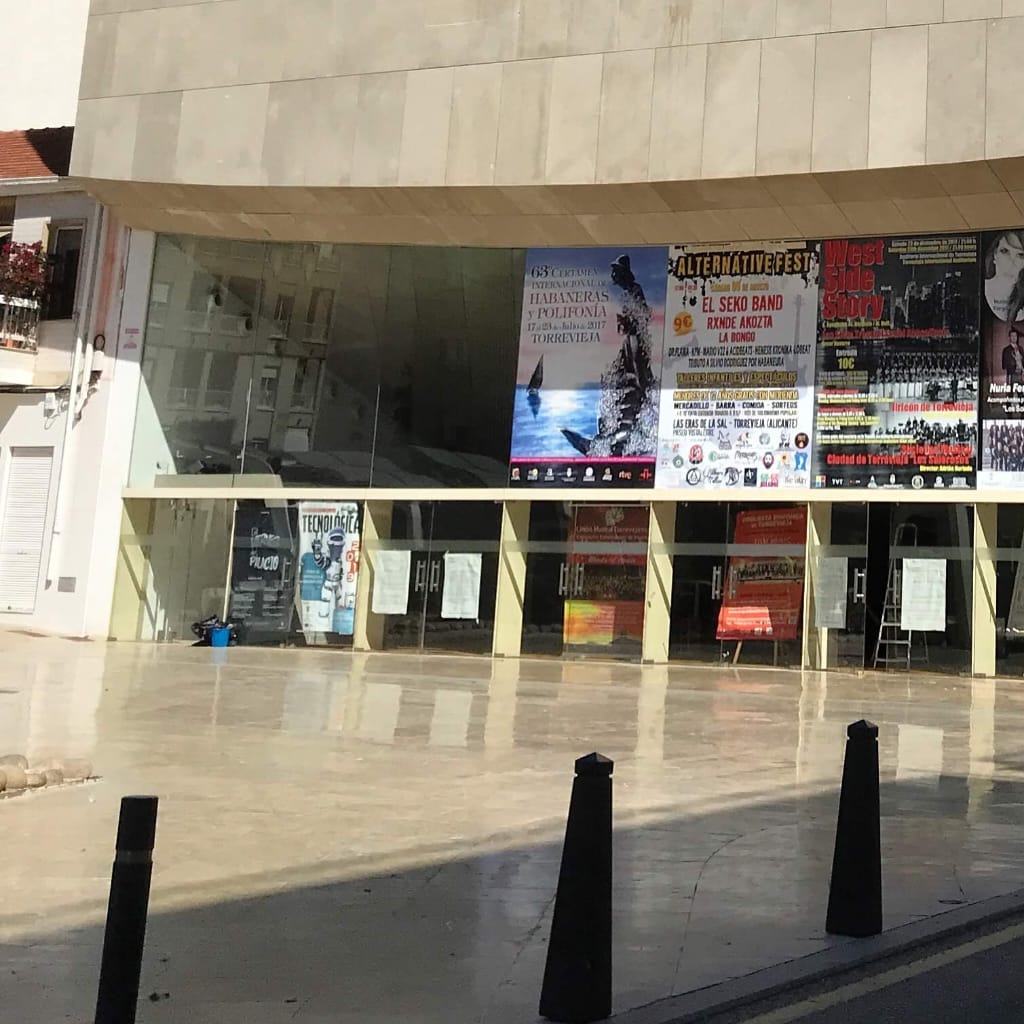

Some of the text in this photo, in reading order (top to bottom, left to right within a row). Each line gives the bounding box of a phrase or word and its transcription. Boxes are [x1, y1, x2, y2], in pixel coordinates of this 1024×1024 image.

[824, 239, 885, 266] West
[677, 251, 811, 276] ALTERNATIVE FEST
[532, 280, 596, 289] INTERNACIONAL
[823, 265, 876, 293] Side
[529, 291, 609, 305] HABANERAS
[702, 294, 783, 313] EL SEKO BAND
[537, 304, 607, 319] POLIFONÍA
[822, 294, 885, 320] Story
[587, 320, 607, 330] 2017
[739, 315, 773, 329] AKOZTA
[532, 333, 601, 344] TORREVIEJA
[989, 383, 1011, 393] Nuria
[674, 401, 709, 409] MERCADILLO
[733, 419, 766, 429] TORREVIEJA
